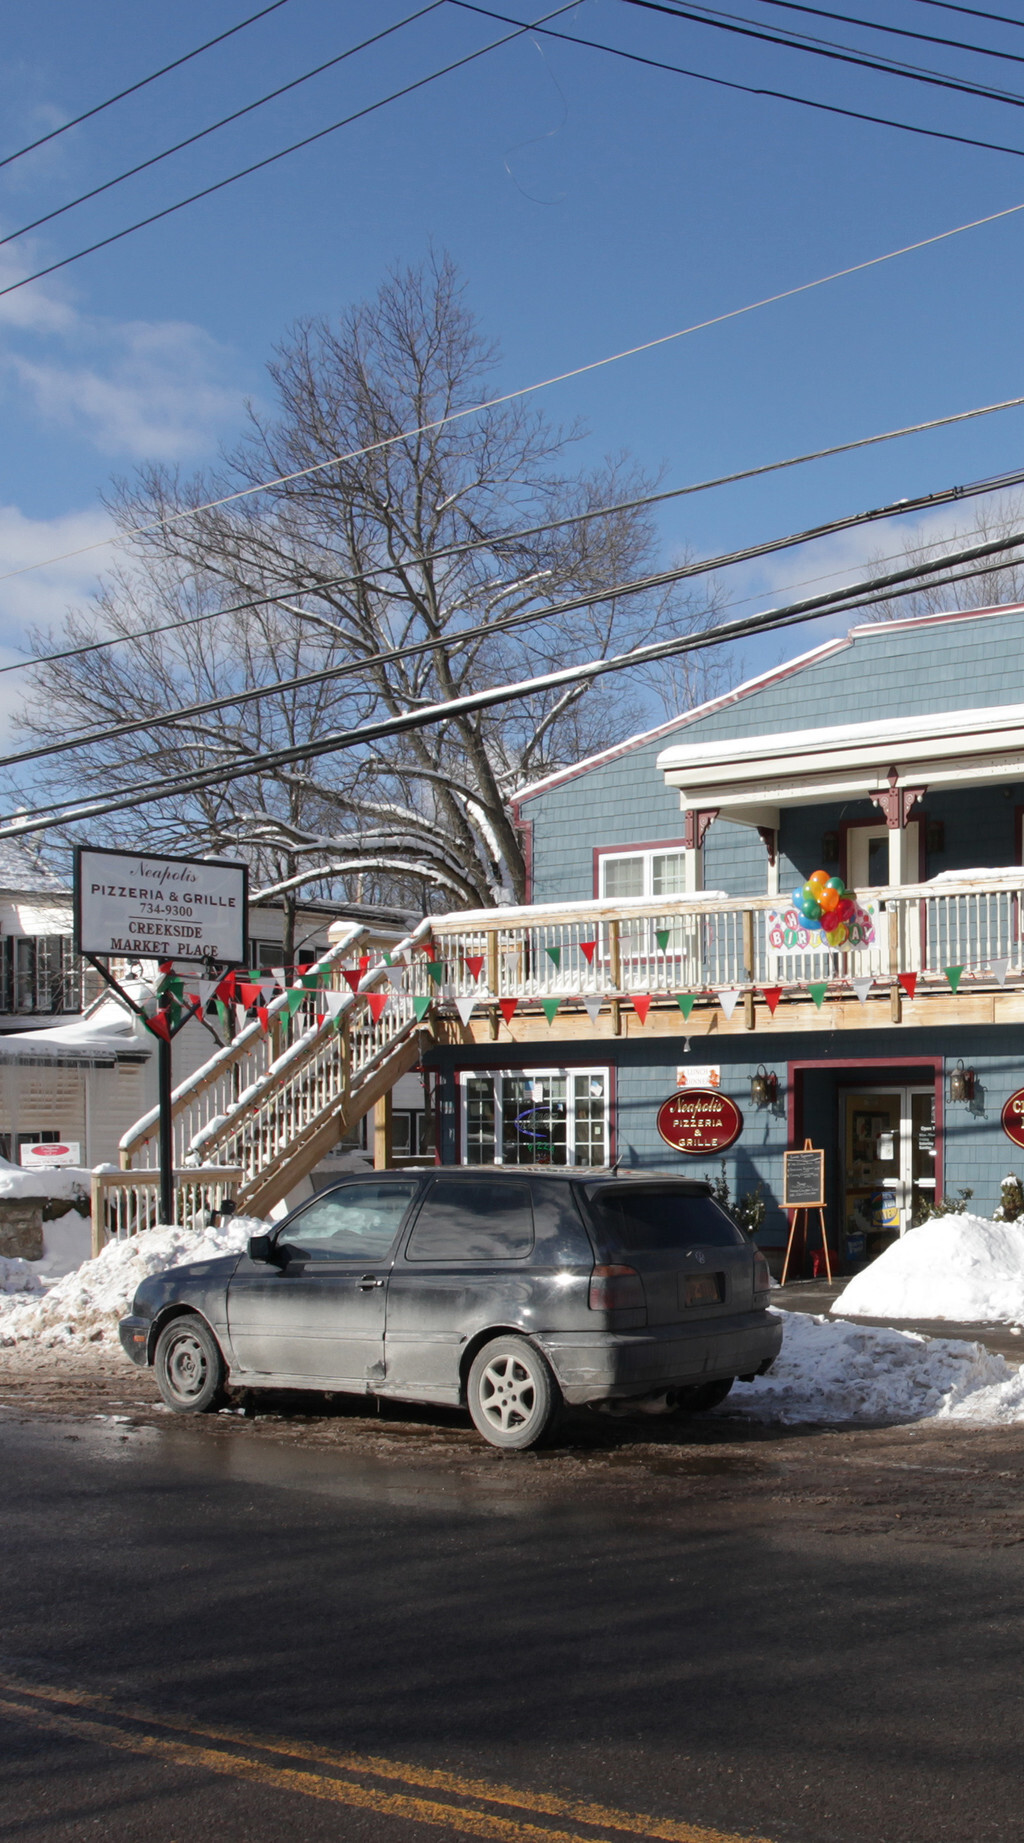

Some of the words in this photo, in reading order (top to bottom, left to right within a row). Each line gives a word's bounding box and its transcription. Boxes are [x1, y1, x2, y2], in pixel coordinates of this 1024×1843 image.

[130, 860, 198, 886] Neapolis
[91, 884, 164, 901] PIZZERIA
[169, 891, 179, 902] &
[183, 893, 236, 908] GRILLE
[139, 903, 193, 917] 734-9300
[128, 921, 203, 939] CREEKSIDE
[773, 926, 873, 945] BIRTAY
[110, 938, 170, 954] MARKET
[178, 943, 219, 957] PLACE
[670, 1096, 724, 1119] Neapolis
[673, 1119, 723, 1128] PIZZERIA
[694, 1129, 702, 1137] &
[527, 1142, 555, 1153] PZZA
[679, 1138, 718, 1147] GRILLE
